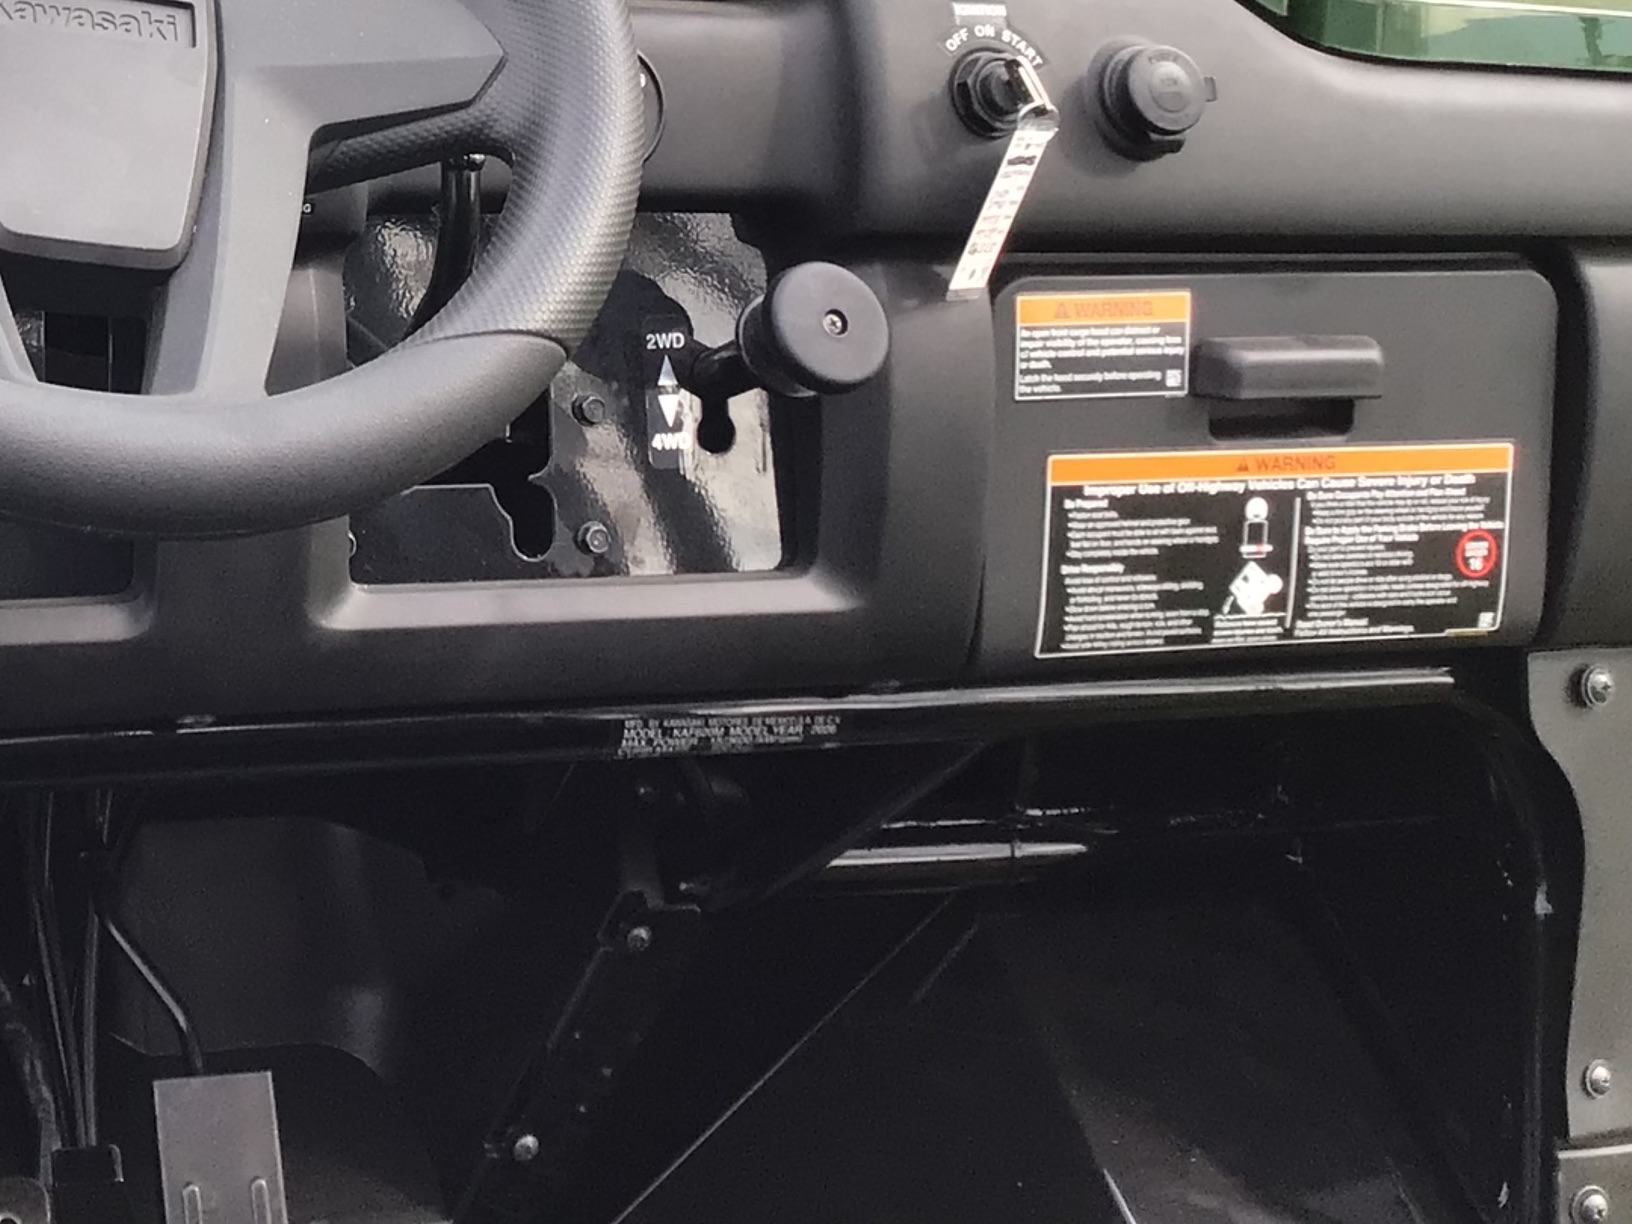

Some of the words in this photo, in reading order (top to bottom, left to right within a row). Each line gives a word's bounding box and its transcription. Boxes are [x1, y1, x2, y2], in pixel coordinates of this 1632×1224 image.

[945, 28, 968, 51] OFF
[974, 24, 995, 37] ON
[1001, 29, 1044, 66] START
[1074, 301, 1154, 317] WARNING
[645, 332, 685, 350] 2WD
[651, 432, 692, 451] 4WD
[1255, 455, 1336, 473] WARNING
[1083, 485, 1136, 498] Improper
[1138, 482, 1161, 495] Use
[1163, 482, 1175, 494] of
[1176, 480, 1245, 495] Off-Highway
[1248, 478, 1295, 491] Vehicles
[1297, 477, 1320, 489] Can
[1321, 476, 1356, 488] Cause
[1357, 476, 1395, 488] Severe
[1396, 474, 1428, 488] Injury
[1429, 475, 1443, 486] or
[1444, 473, 1476, 485] Death
